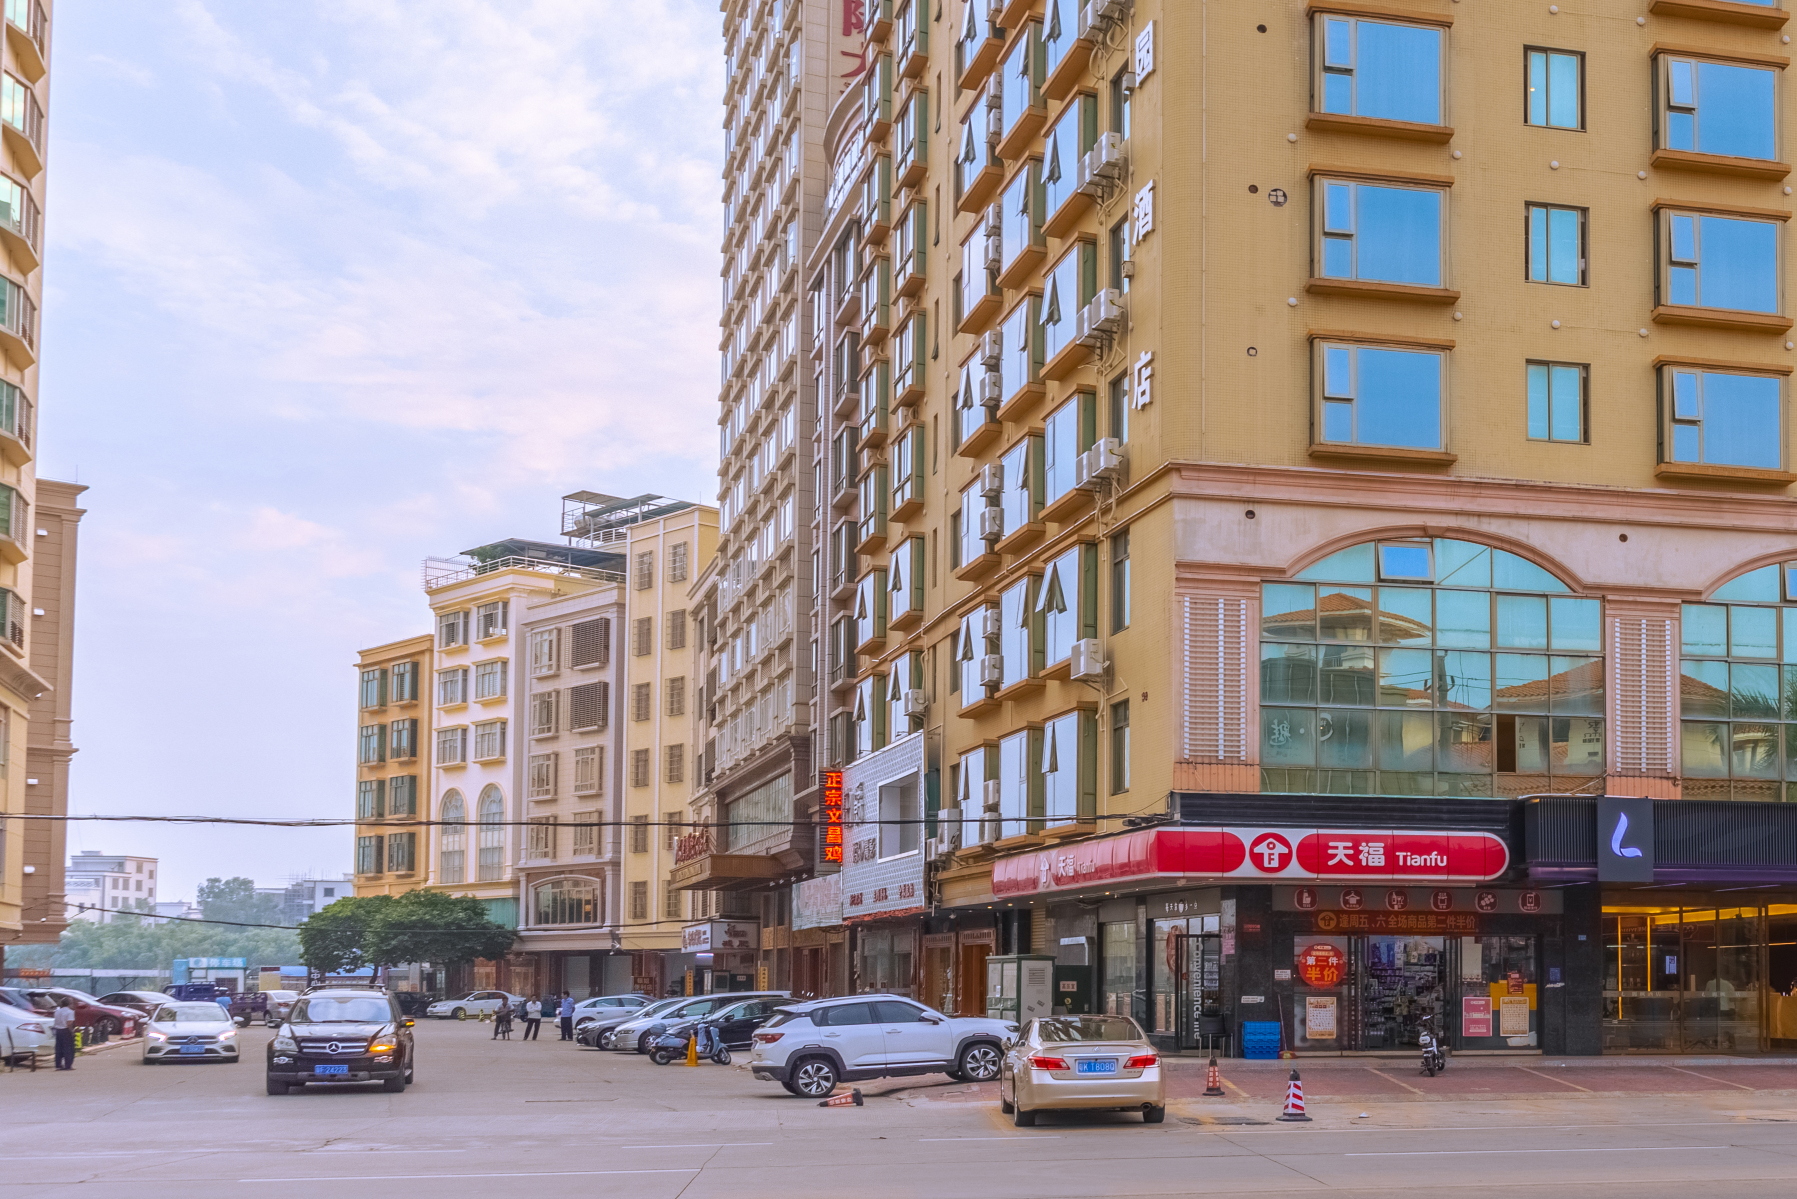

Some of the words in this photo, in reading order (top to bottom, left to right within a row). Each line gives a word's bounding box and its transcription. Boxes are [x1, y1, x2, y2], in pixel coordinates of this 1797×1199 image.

[825, 772, 843, 862] 正宗文昌鸡
[1327, 840, 1386, 867] 天福
[1395, 850, 1448, 868] Tianfu
[1058, 854, 1076, 877] 天福
[208, 958, 245, 967] 停车场
[1306, 955, 1339, 966] 第二件
[1305, 966, 1338, 982] 半价
